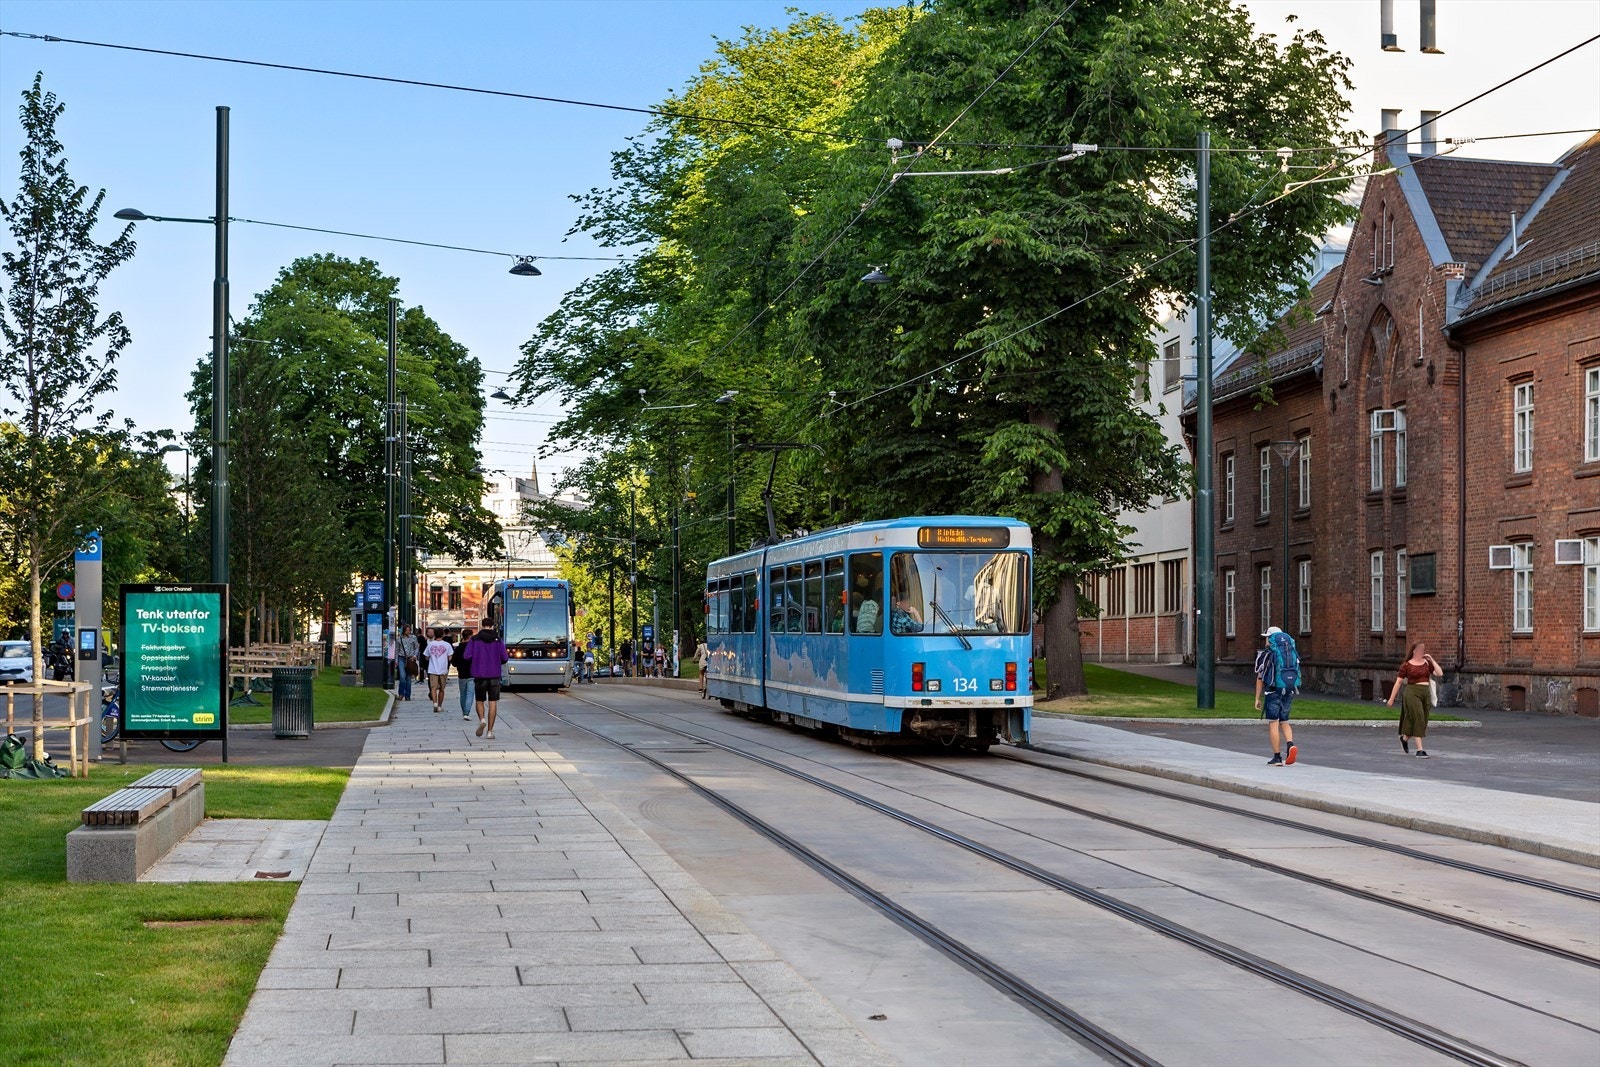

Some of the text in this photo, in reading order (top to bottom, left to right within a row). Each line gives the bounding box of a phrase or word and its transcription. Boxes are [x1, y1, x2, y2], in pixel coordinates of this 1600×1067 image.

[512, 589, 520, 600] 17
[136, 609, 210, 619] Tenk utenfor
[142, 624, 204, 633] TV-boksen
[141, 654, 190, 662] Oppsigelsestid
[952, 678, 978, 692] 134
